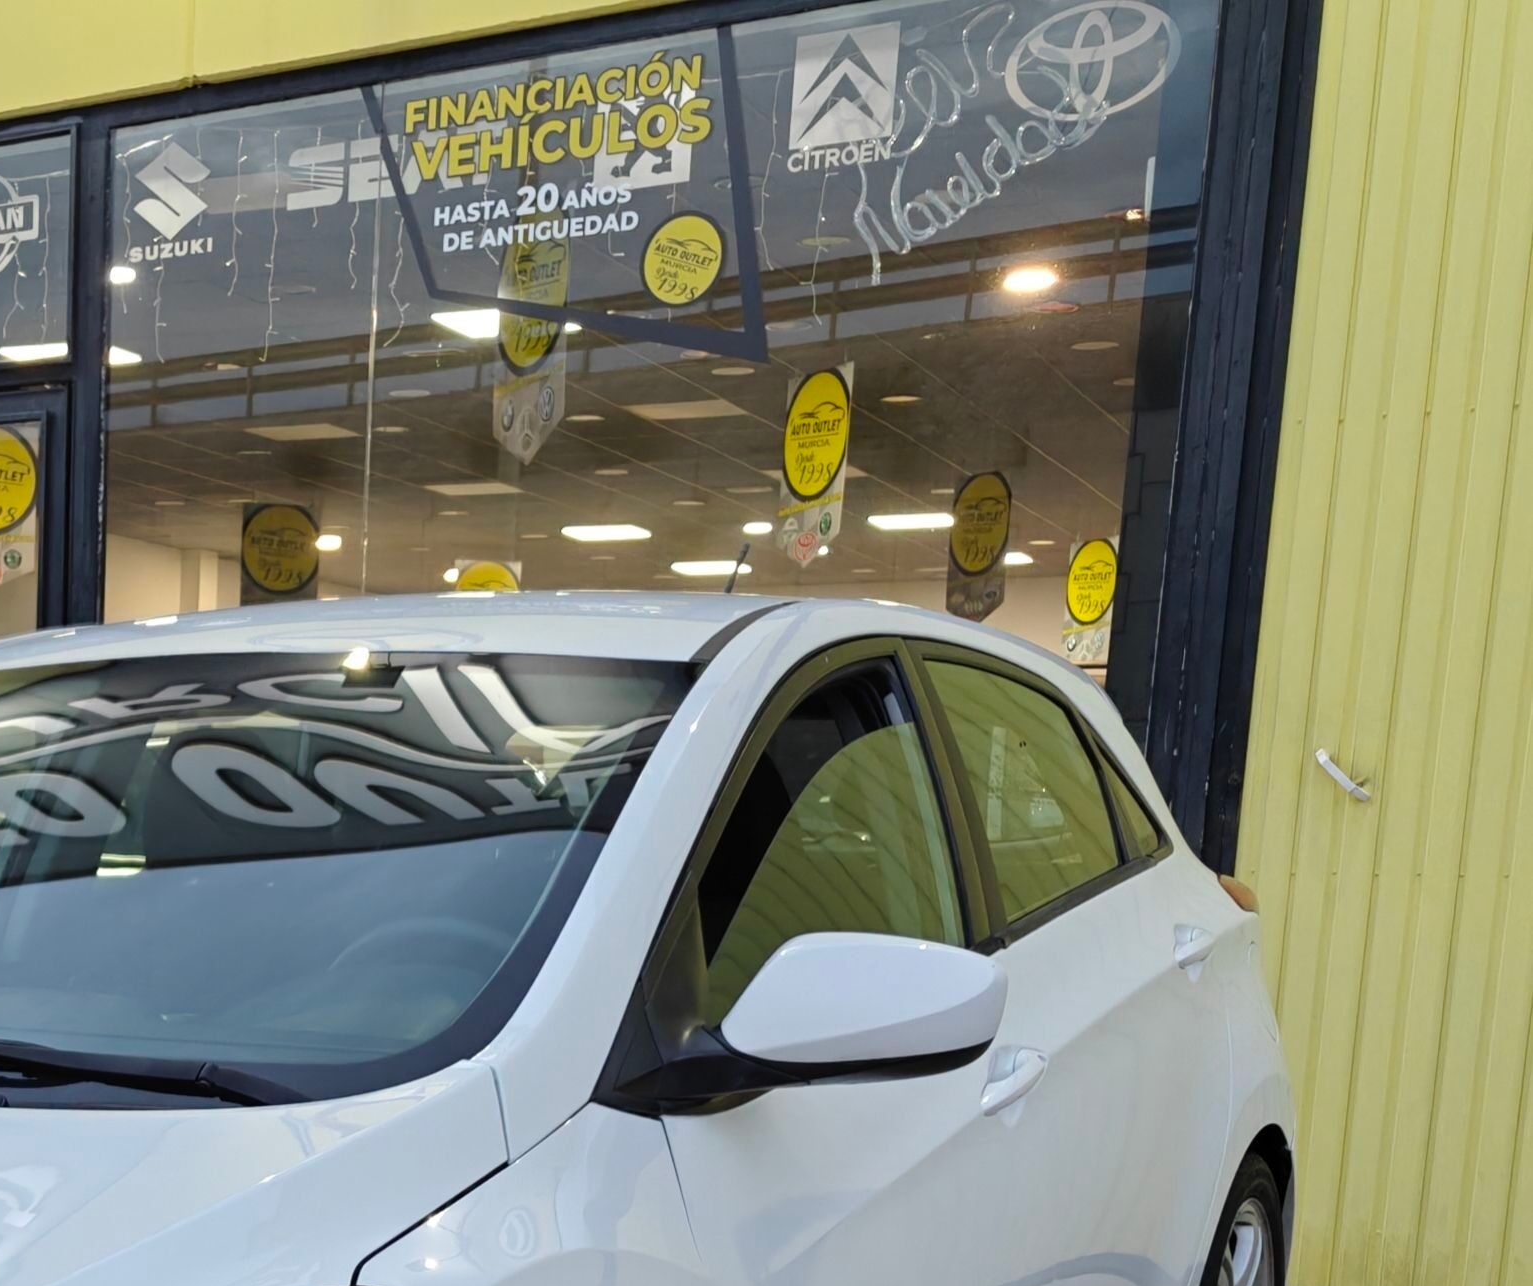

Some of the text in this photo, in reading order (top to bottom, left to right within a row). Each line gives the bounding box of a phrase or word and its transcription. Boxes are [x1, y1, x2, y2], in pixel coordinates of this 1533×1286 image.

[404, 51, 703, 134] FINANCIACIÓN
[412, 97, 711, 180] VEHÍCULOS
[787, 139, 892, 173] CITROËN
[433, 182, 632, 226] HASTA 20 AÑOS
[443, 211, 639, 253] DE ANTIGUEDAD
[129, 237, 213, 263] SUZUKI
[654, 243, 714, 266] AUTO OUTLET
[660, 258, 697, 274] MURCIA
[657, 277, 699, 300] 1998
[791, 419, 841, 436] AUTO OUTLET
[798, 438, 831, 449] MURCIA
[799, 462, 833, 485] 1998
[1074, 572, 1112, 581] AUTO OUTLET
